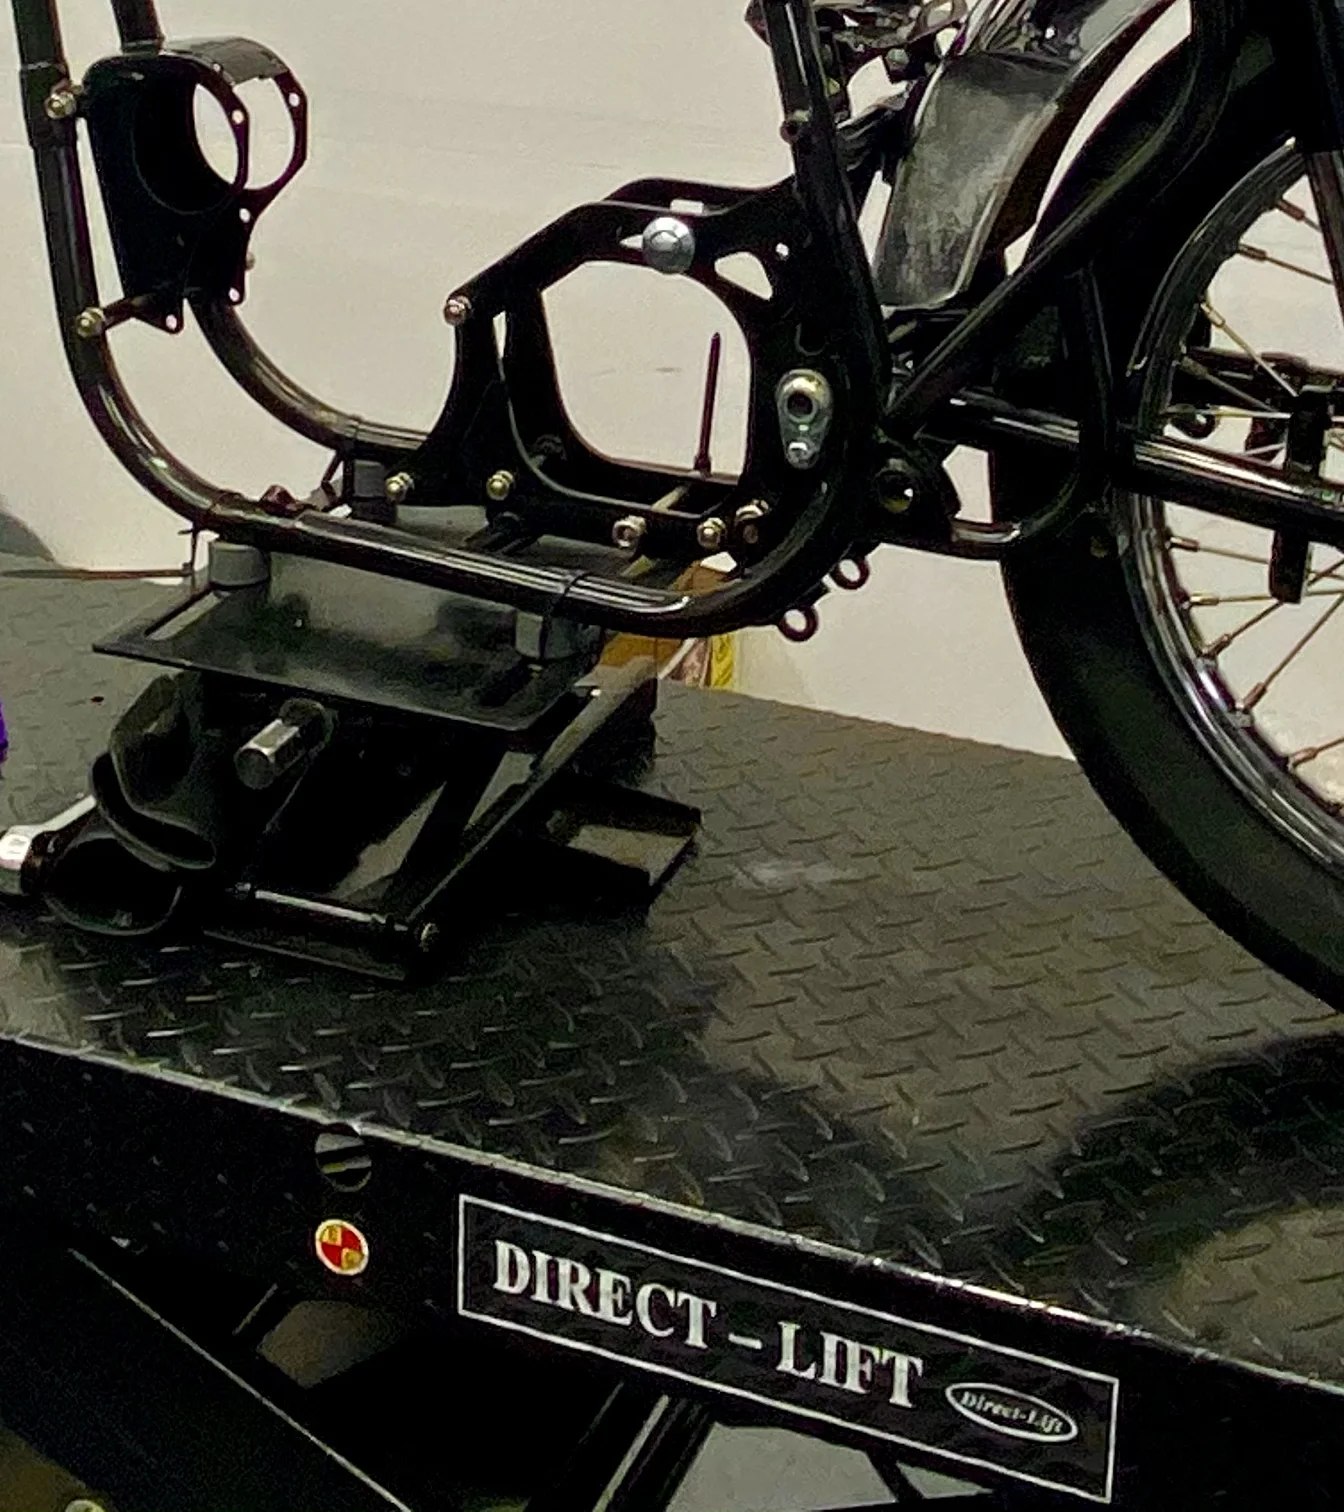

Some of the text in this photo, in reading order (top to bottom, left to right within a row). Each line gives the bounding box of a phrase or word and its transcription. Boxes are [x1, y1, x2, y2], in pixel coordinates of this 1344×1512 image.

[493, 1239, 717, 1349] DIRECT
[776, 1321, 923, 1408] LIFT
[960, 1391, 1063, 1433] Direct-Lift
